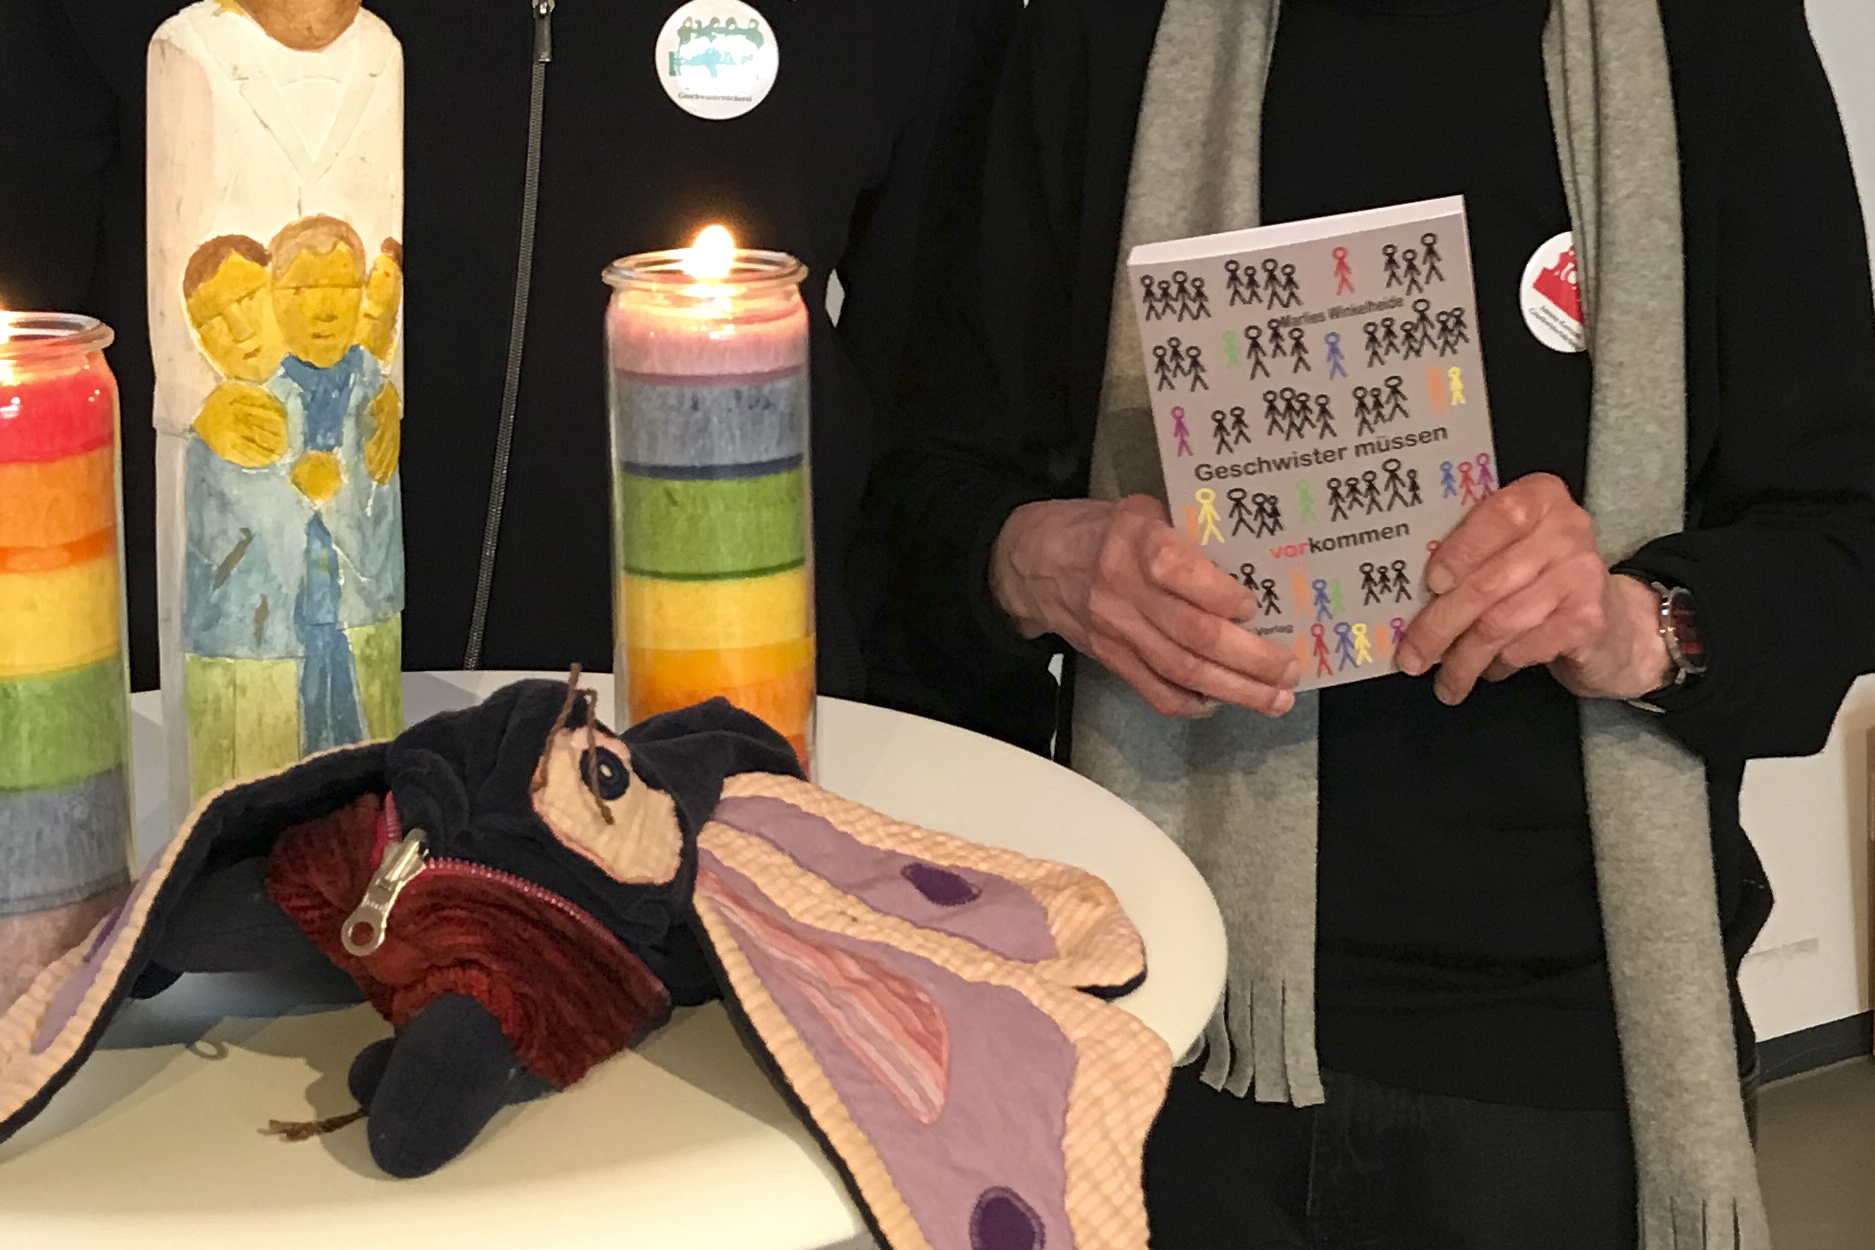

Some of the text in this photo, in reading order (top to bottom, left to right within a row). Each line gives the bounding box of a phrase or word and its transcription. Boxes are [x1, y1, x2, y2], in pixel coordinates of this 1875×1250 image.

[1194, 426, 1449, 482] Geschwister müssen
[1270, 522, 1411, 559] vorkommen
